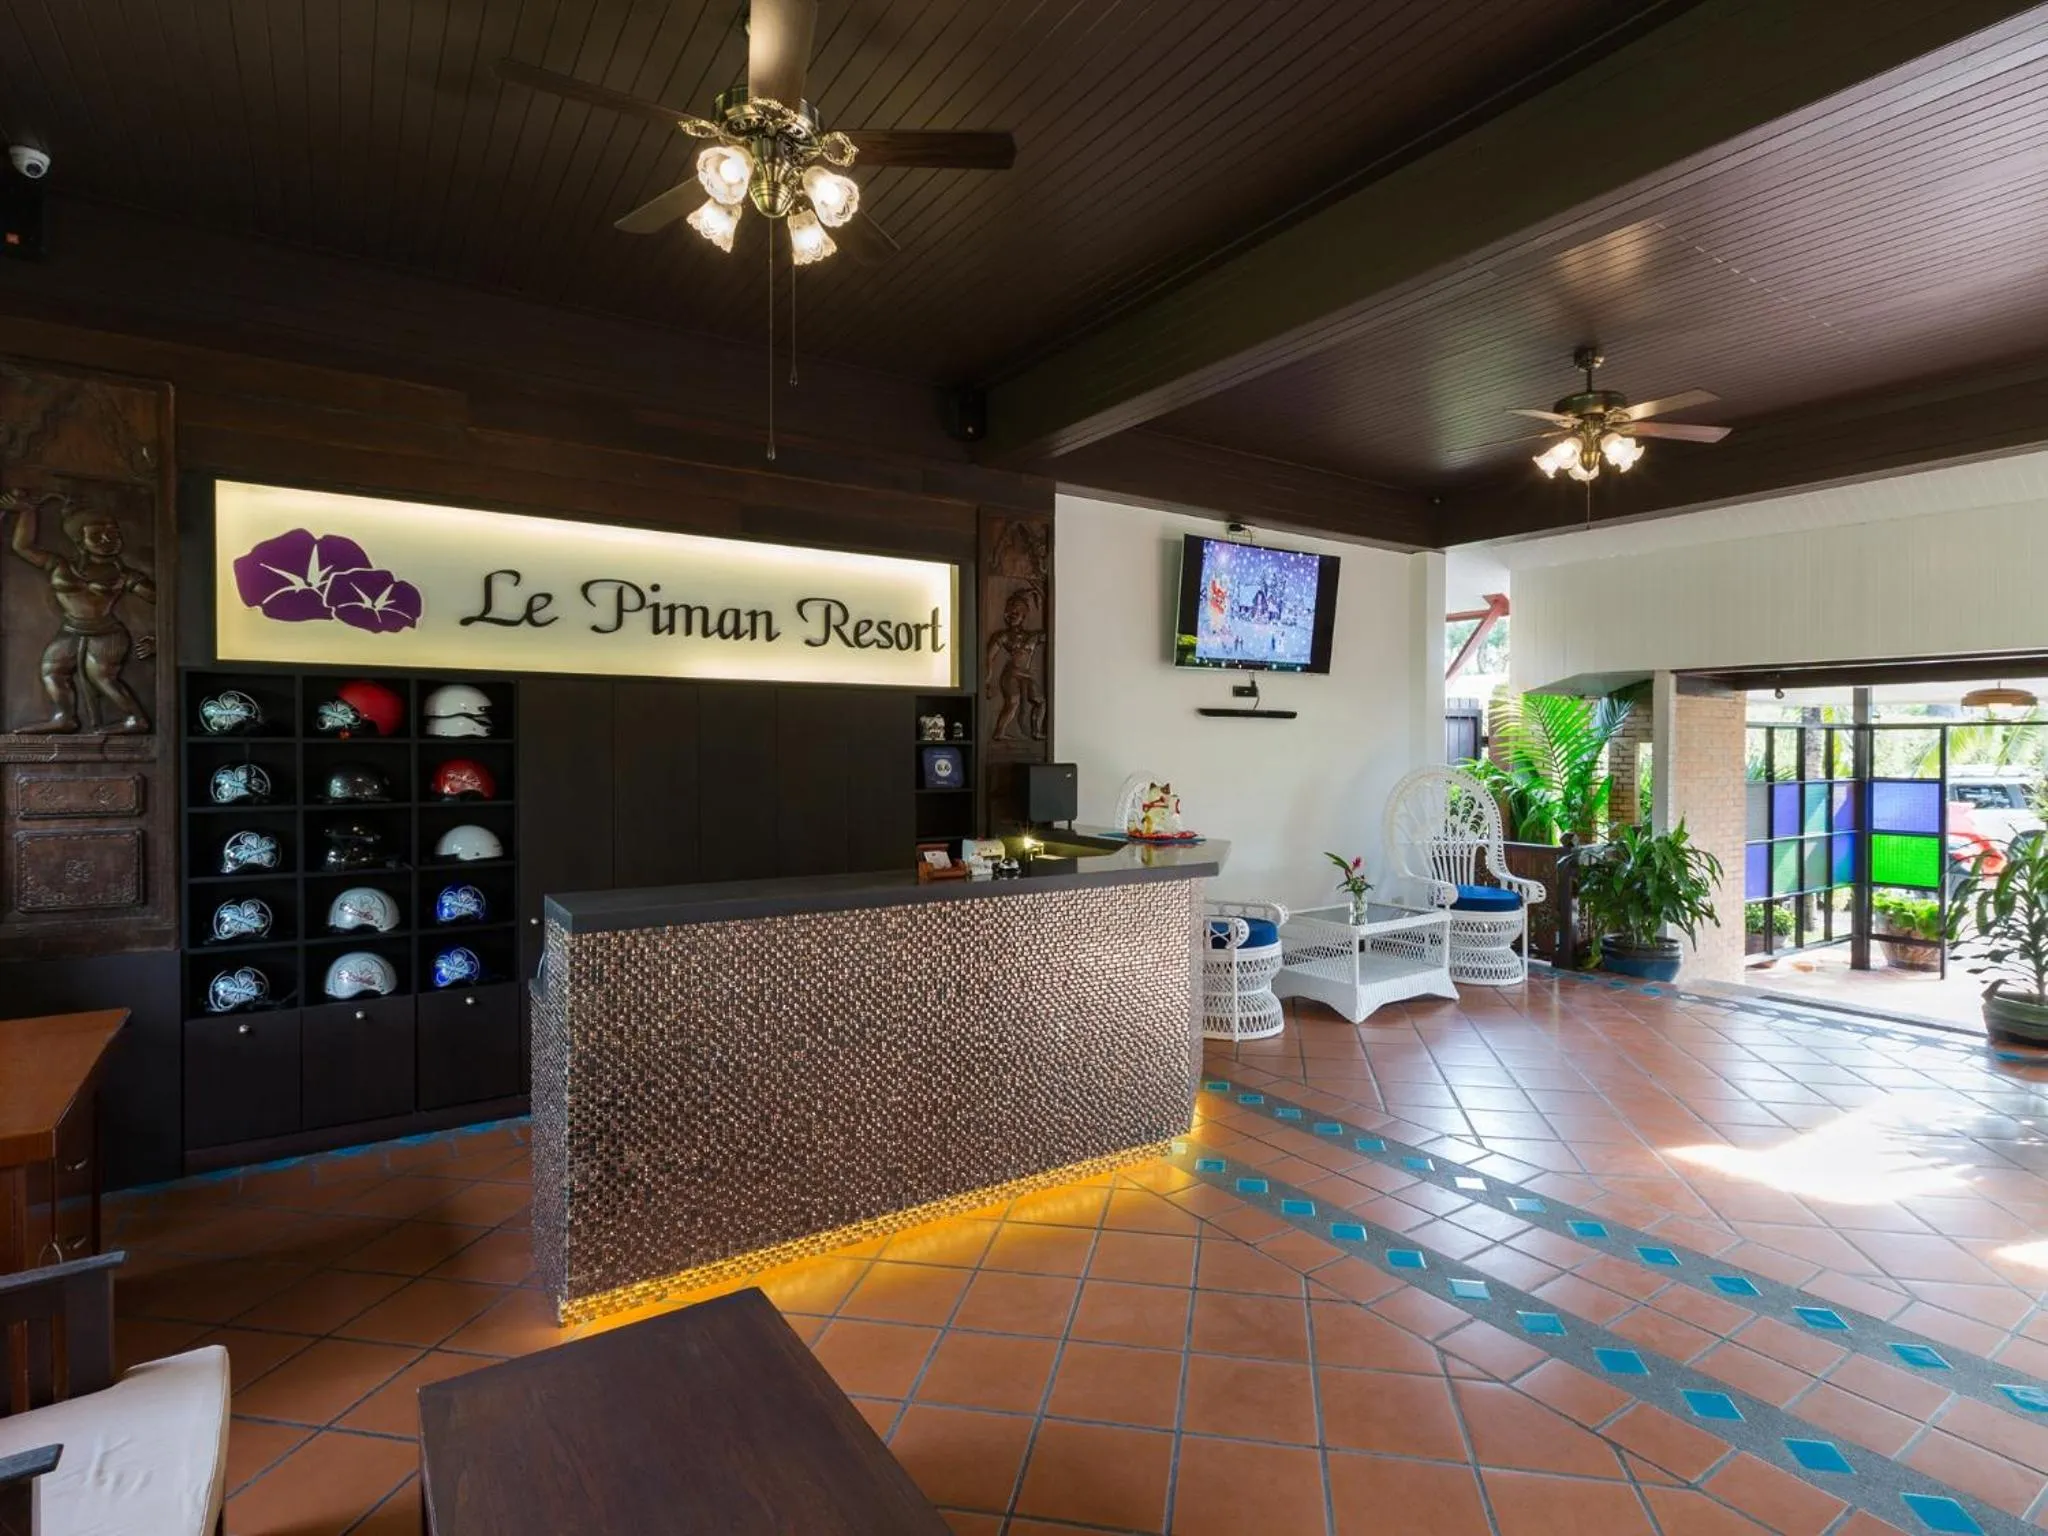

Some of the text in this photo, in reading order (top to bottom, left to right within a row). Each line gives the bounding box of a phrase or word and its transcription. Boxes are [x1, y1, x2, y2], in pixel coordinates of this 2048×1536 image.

[458, 569, 945, 653] Le Piman Resort
